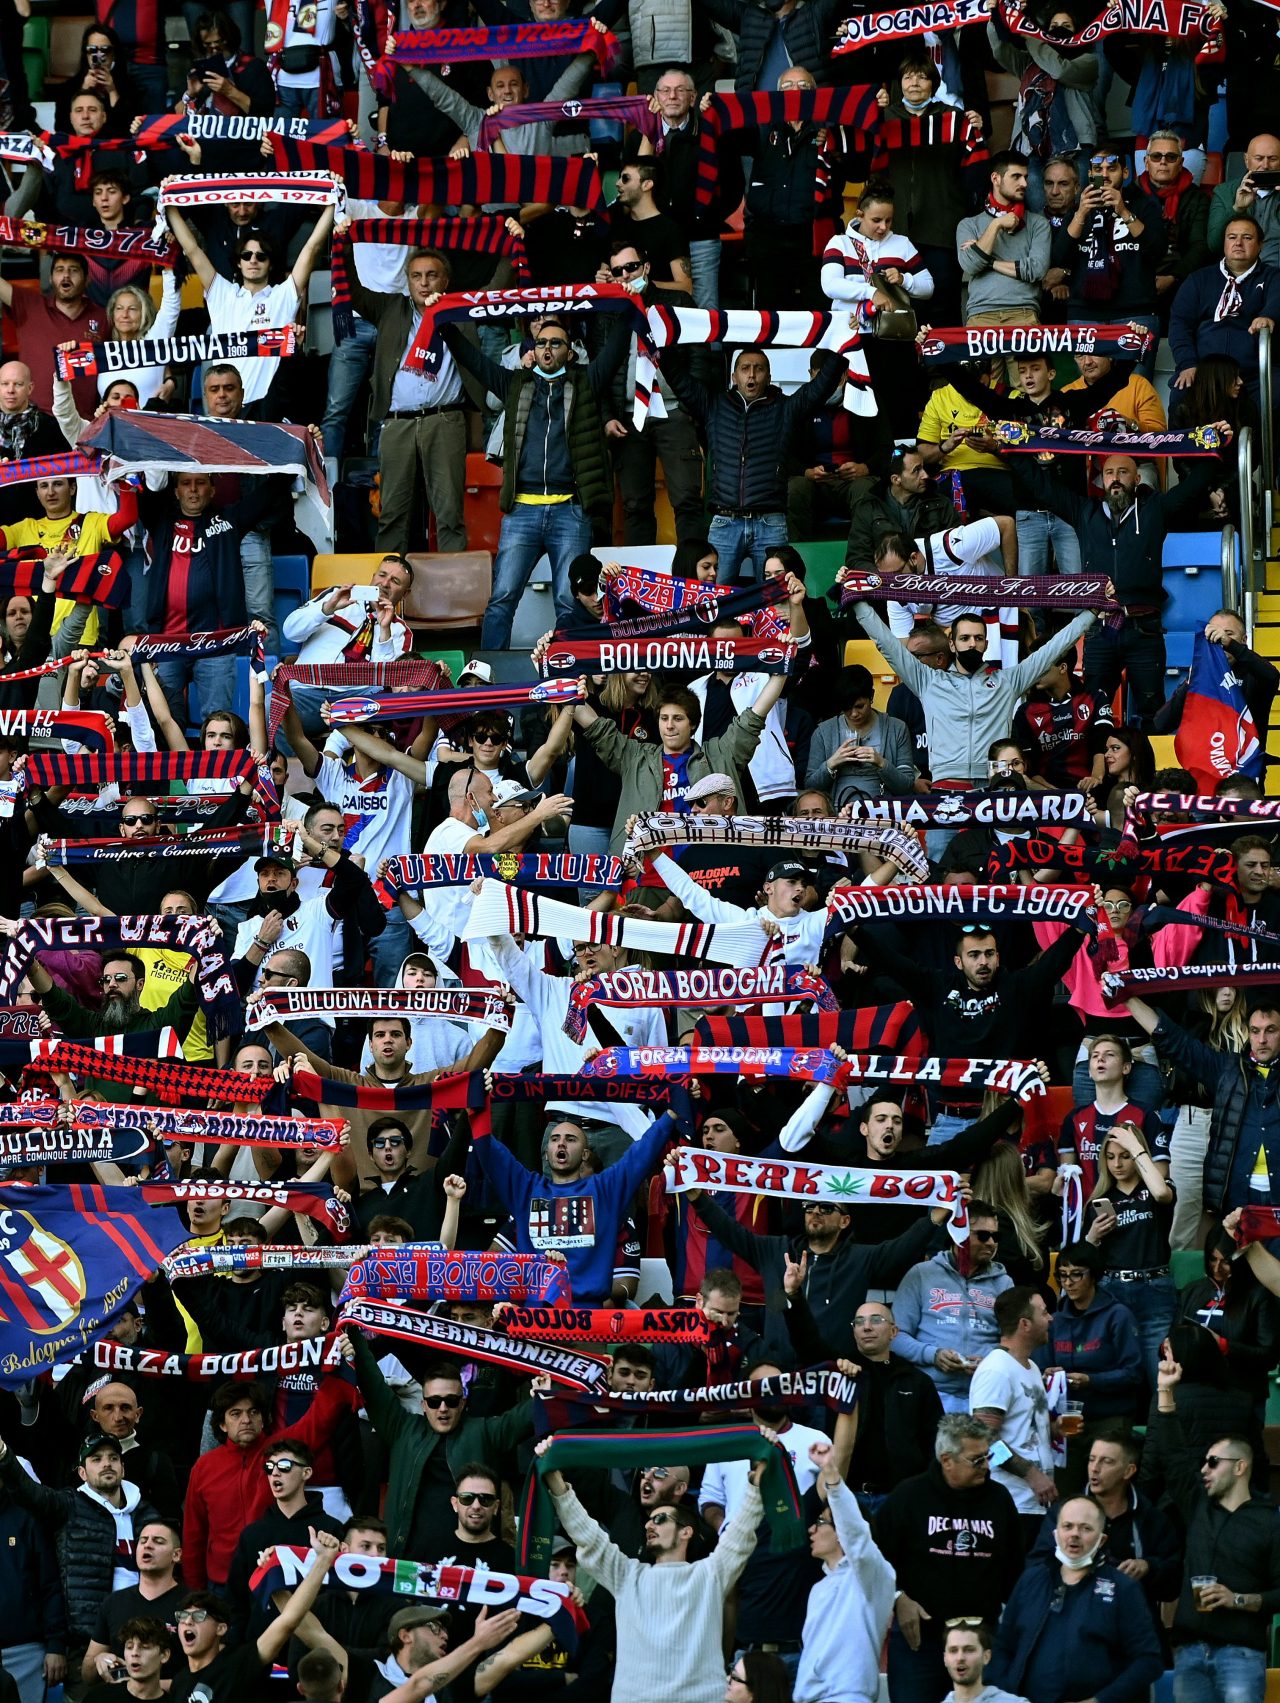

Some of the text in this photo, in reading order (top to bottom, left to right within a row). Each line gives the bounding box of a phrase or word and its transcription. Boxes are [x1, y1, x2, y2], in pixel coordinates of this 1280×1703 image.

[188, 114, 310, 141] BOLOGNA FC
[162, 190, 329, 206] BOLOGNA 1974
[55, 226, 170, 256] 1974
[461, 284, 598, 305] VECCHIA
[468, 300, 594, 319] GUARDIA
[105, 331, 249, 369] BOLOGNA FC
[227, 345, 249, 358] 1909
[967, 328, 1098, 357] BOLOGNA FC
[1075, 343, 1095, 354] 1909
[414, 347, 438, 363] 1974
[690, 583, 726, 594] DELLA
[890, 572, 989, 599] Bologna
[1047, 581, 1101, 598] 1909
[130, 632, 189, 662] ologna
[599, 640, 737, 673] BOLOGNA FC
[713, 659, 735, 670] 1909
[34, 710, 59, 727] FC
[31, 727, 52, 738] 1909
[93, 849, 145, 863] Sempre
[161, 844, 241, 861] Comunque
[388, 853, 622, 887] CURVA NORD
[834, 884, 1090, 922] BOLOGNA FC 1909
[1181, 962, 1238, 976] Andrea
[605, 966, 785, 999] FORZA BOLOGNA
[288, 990, 453, 1012] BOLOGNA FC 1909
[629, 1047, 782, 1069] FORZA BOLOGNA
[520, 1079, 672, 1101] IN TUA DIFESA
[113, 1107, 300, 1142] FORZA BOLOGNA
[25, 1151, 71, 1164] COMUNQUE
[73, 1148, 114, 1160] DOVUNQUE
[171, 1184, 289, 1204] BOLOGNA
[102, 1275, 130, 1314] 1909
[380, 1311, 478, 1347] BAYERN
[200, 1340, 343, 1376] BOLOGNA
[760, 1381, 774, 1396] A
[779, 1375, 859, 1404] BASTONI
[399, 1581, 457, 1598] 19 82
